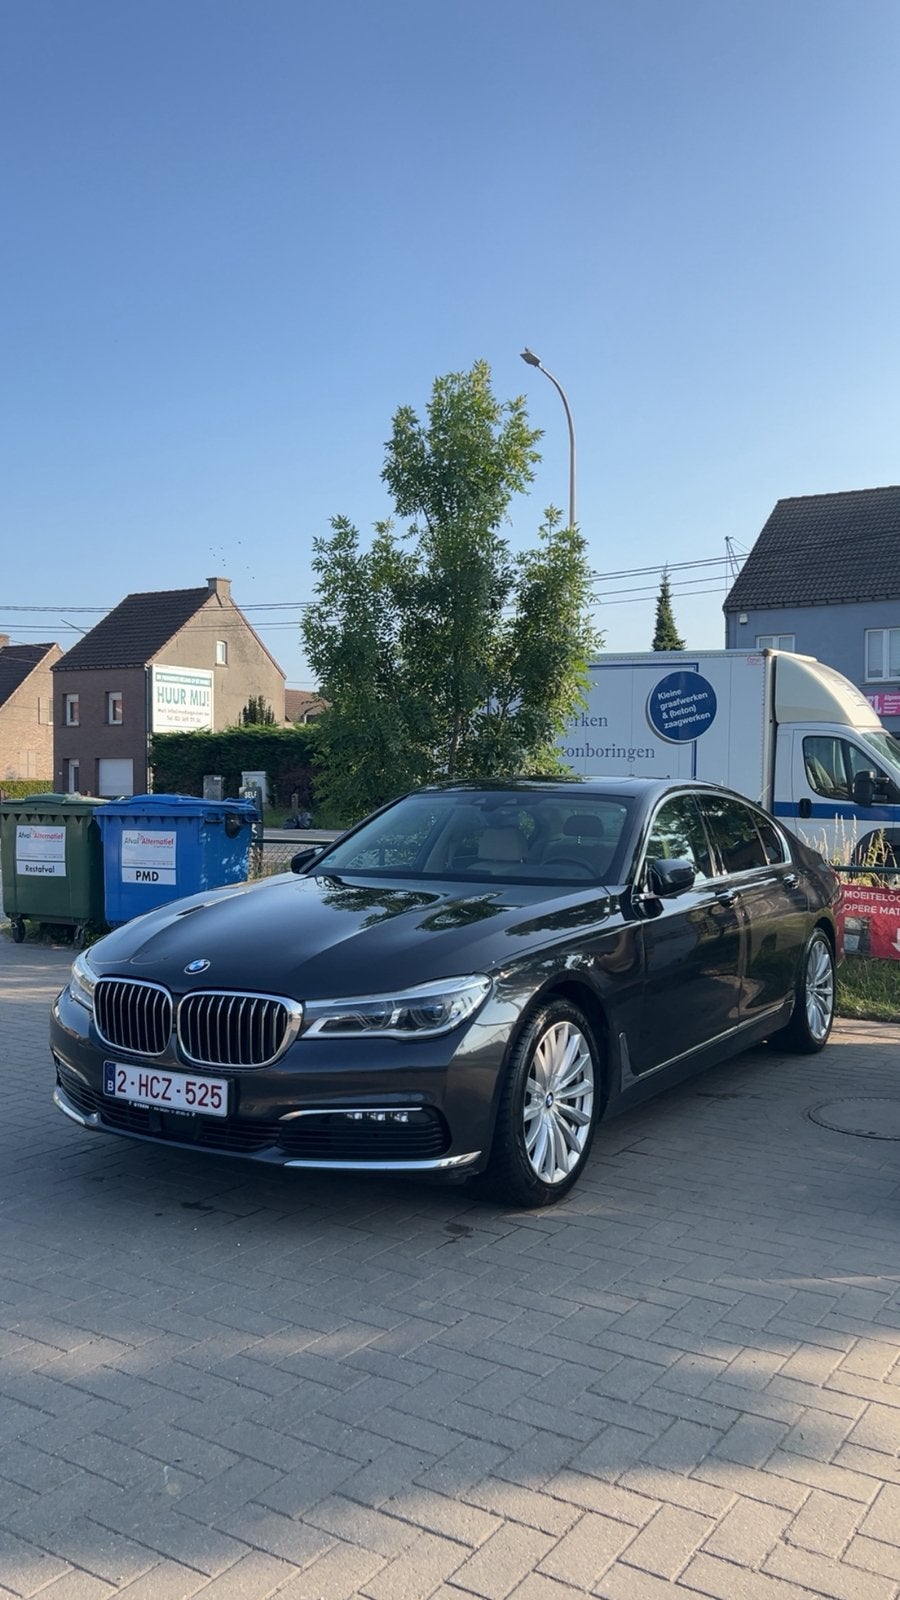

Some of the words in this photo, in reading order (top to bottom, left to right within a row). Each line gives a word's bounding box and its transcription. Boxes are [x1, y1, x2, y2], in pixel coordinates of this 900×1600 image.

[157, 686, 187, 705] HUUR
[190, 689, 210, 707] MIJ!
[657, 689, 682, 700] Kleine
[660, 692, 708, 711] graafwerken
[669, 704, 697, 718] (beton)
[565, 712, 608, 727] erken
[664, 712, 711, 729] zaagwerken
[25, 864, 55, 873] Restafval
[135, 870, 159, 882] PMD
[843, 903, 877, 914] OPERE
[107, 1080, 114, 1091] B
[117, 1070, 222, 1109] 2-HCZ-525
